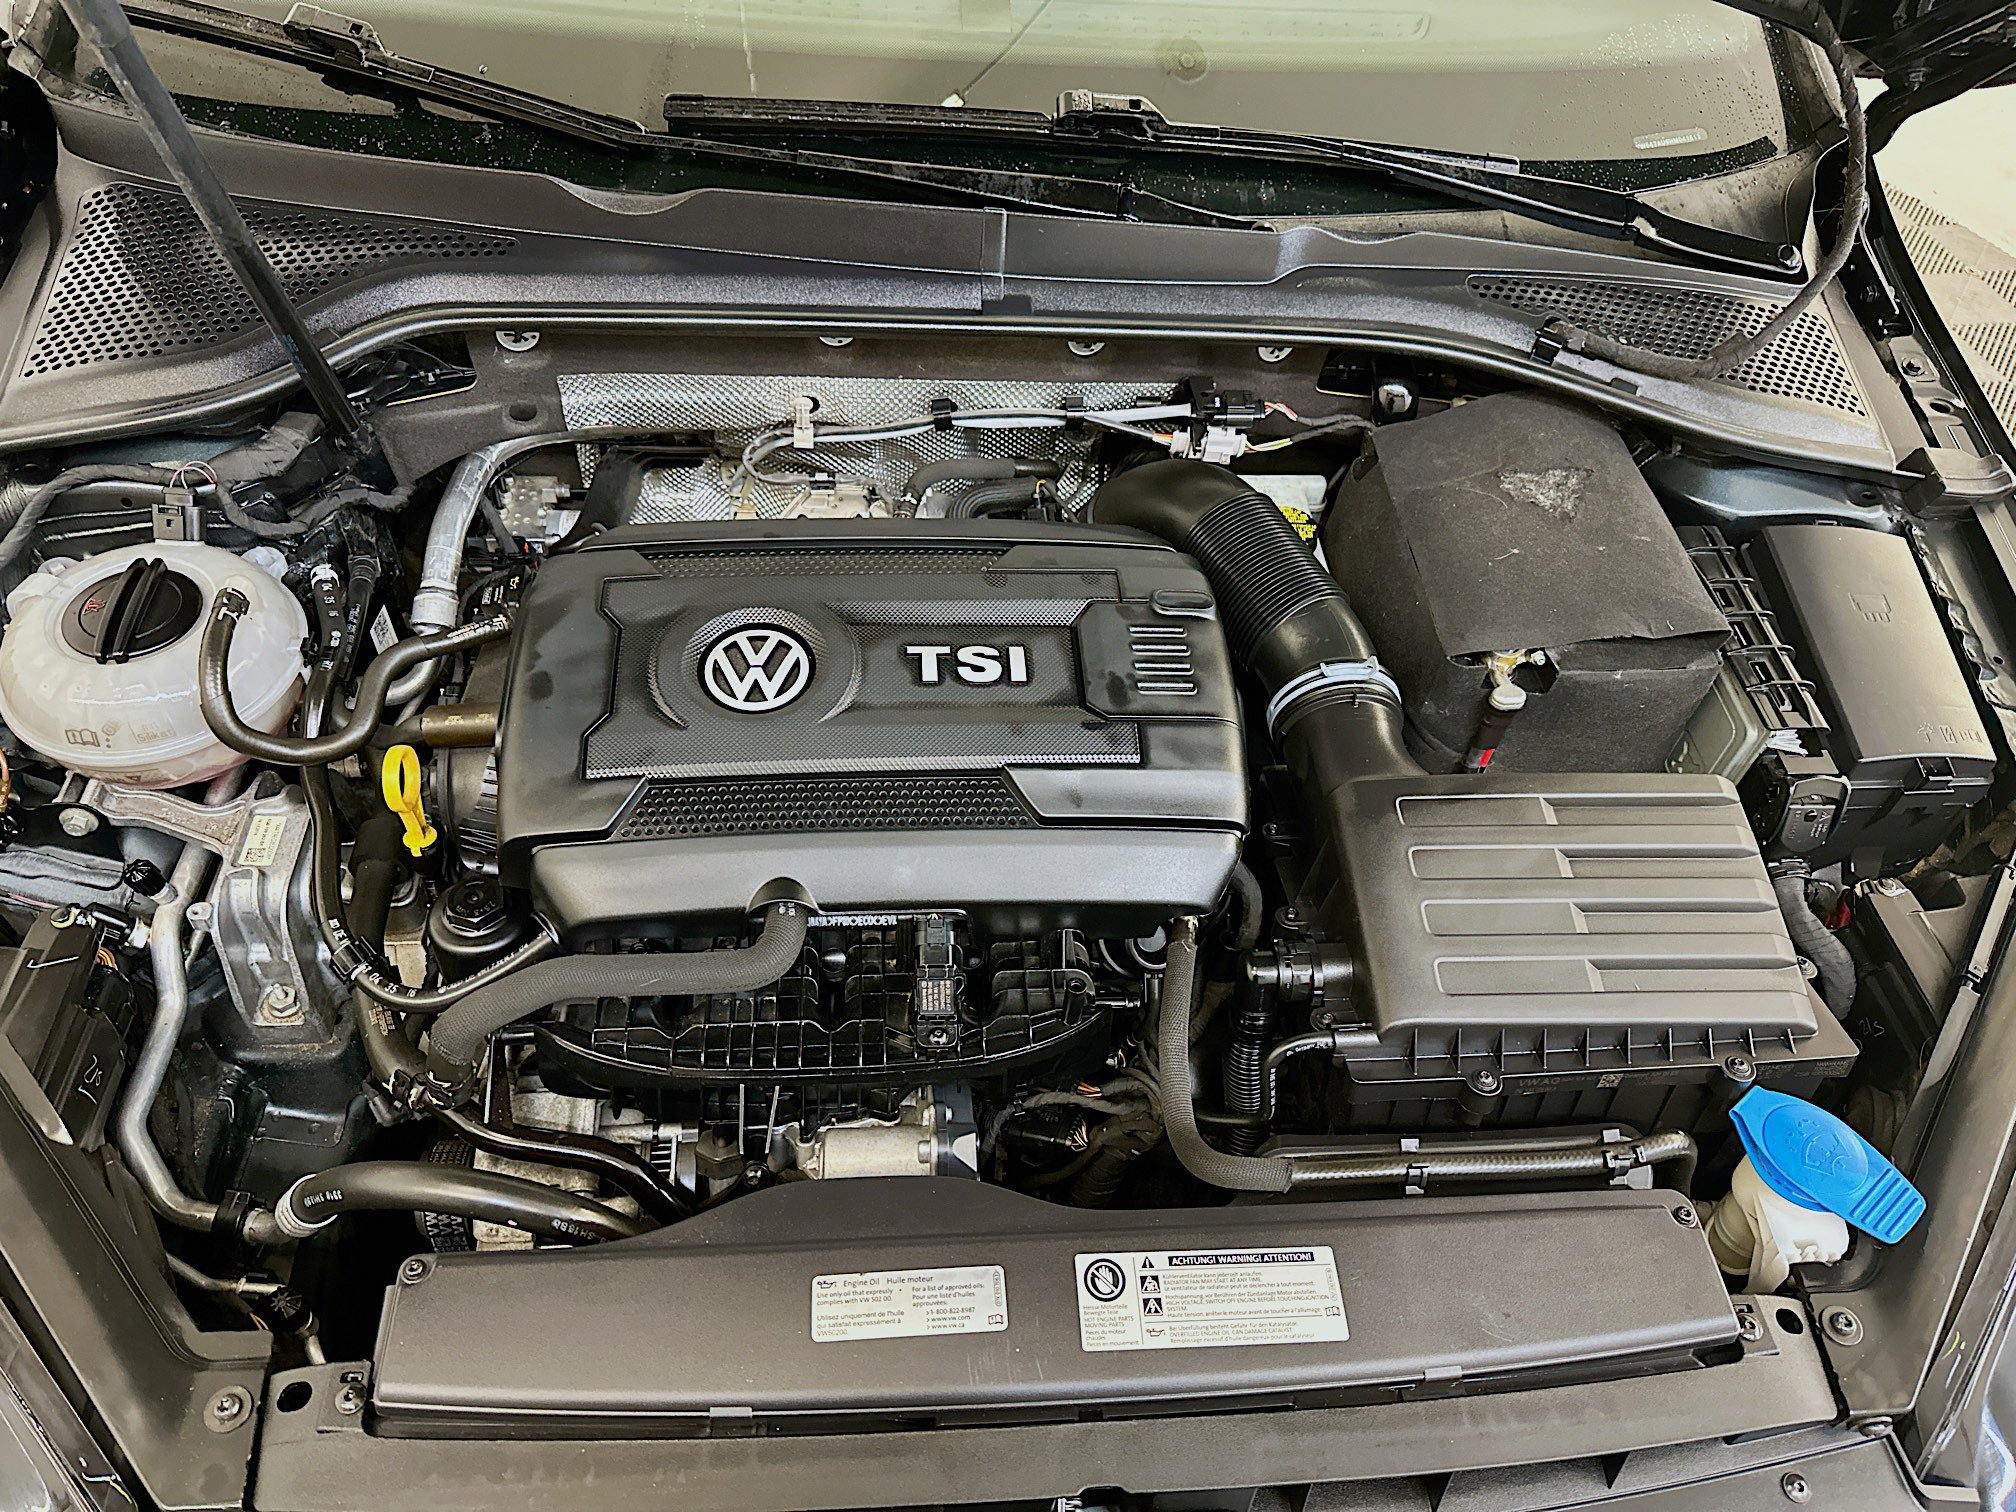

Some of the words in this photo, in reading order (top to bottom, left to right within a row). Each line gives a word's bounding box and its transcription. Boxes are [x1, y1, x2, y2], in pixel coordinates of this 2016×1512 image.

[906, 645, 1028, 683] TSI
[137, 729, 174, 743] Silikat
[1171, 1255, 1216, 1265] ACHTUNG!
[1217, 1253, 1262, 1263] WARNING!
[1262, 1252, 1312, 1262] ATTENTION!
[843, 1279, 867, 1288] Engine
[886, 1276, 905, 1284] Huile
[907, 1275, 933, 1283] moteur
[944, 1282, 972, 1291] approved
[865, 1287, 893, 1296] expressly
[816, 1298, 843, 1307] complies
